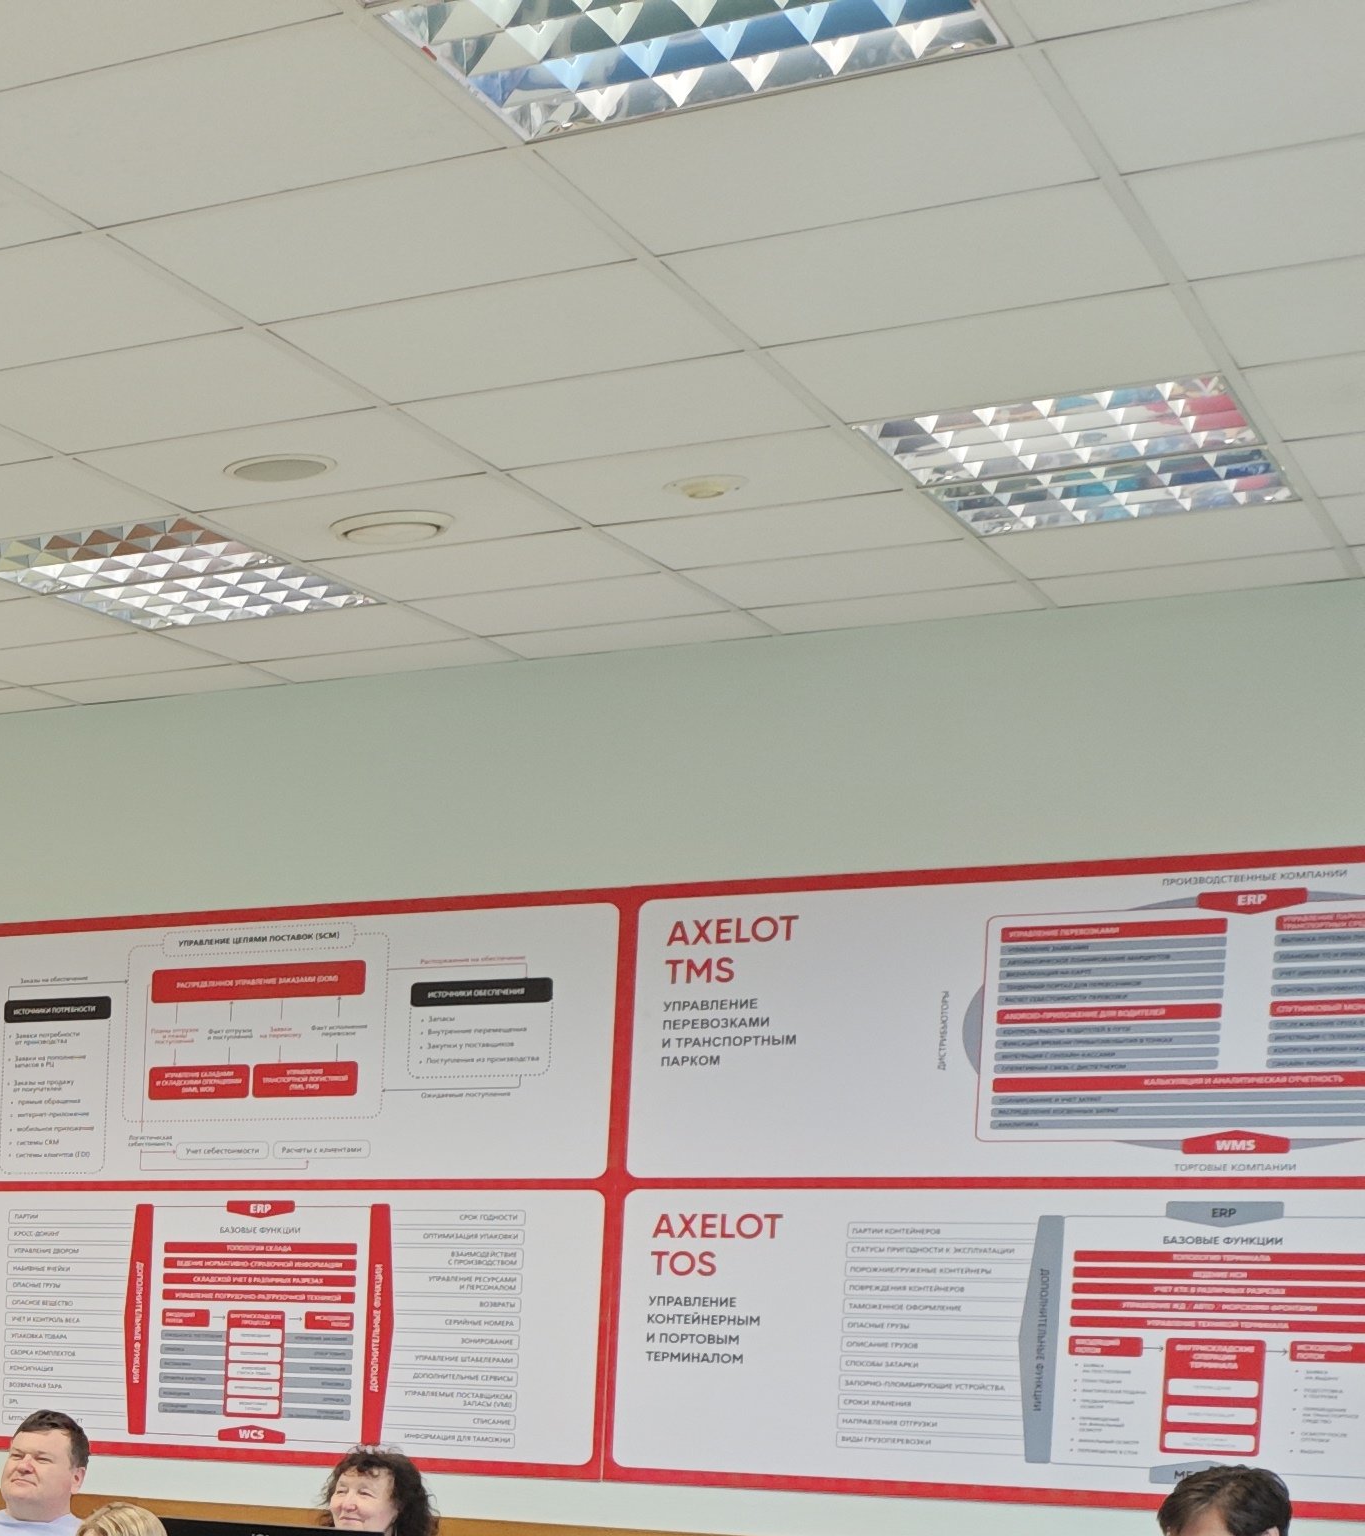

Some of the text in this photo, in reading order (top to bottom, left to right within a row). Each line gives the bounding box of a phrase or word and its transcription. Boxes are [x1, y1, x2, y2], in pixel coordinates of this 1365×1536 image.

[1161, 868, 1347, 887] ПРОИЗВОДСТВЕННЫЕ КОМПАНИИ
[1237, 893, 1267, 906] ERP
[666, 914, 799, 946] AXELOT
[178, 931, 339, 947] УПРАВЛЕНИЕ ЦЕПЯМИ ПОСТАВОК (SCM)
[665, 956, 734, 984] TMS
[663, 997, 757, 1012] УПРАВЛЕНИЕ
[662, 1016, 769, 1030] ПЕРЕВОЗКАМИ
[937, 990, 950, 1071] ДИСТРИБЬЮТОРЫ
[661, 1034, 796, 1048] И ТРАНСПОРТНЫМ
[660, 1055, 720, 1066] ПАРКОМ
[1215, 1139, 1255, 1150] WMS
[1174, 1163, 1296, 1171] ТОРГОВЫЕ КОМПАНИИ
[249, 1203, 271, 1213] ERP
[1211, 1207, 1237, 1218] ERP
[219, 1225, 301, 1234] БАЗОВЫЕ ФУНКЦИИ
[652, 1213, 783, 1239] AXELOT
[1162, 1235, 1283, 1246] БАЗОВЫЕ ФУНКЦИИ
[851, 1245, 885, 1253] СТАТУСЫ
[650, 1250, 716, 1276] TOS
[648, 1295, 736, 1307] УПРАВЛЕНИЕ
[646, 1311, 760, 1326] КОНТЕЙНЕРНЫМ
[369, 1264, 384, 1393] ДОПОЛНИТЕЛЬНЫЕ ФУНКЦИИ
[646, 1332, 739, 1345] И ПОРТОВЫМ
[1032, 1268, 1050, 1412] ДОПОЛНИТЕЛЬНЫЕ ФУНКЦИИ
[132, 1341, 142, 1384] ФУНКЦИИ
[645, 1350, 743, 1364] ТЕРМИНАЛОМ
[238, 1428, 264, 1440] WCS
